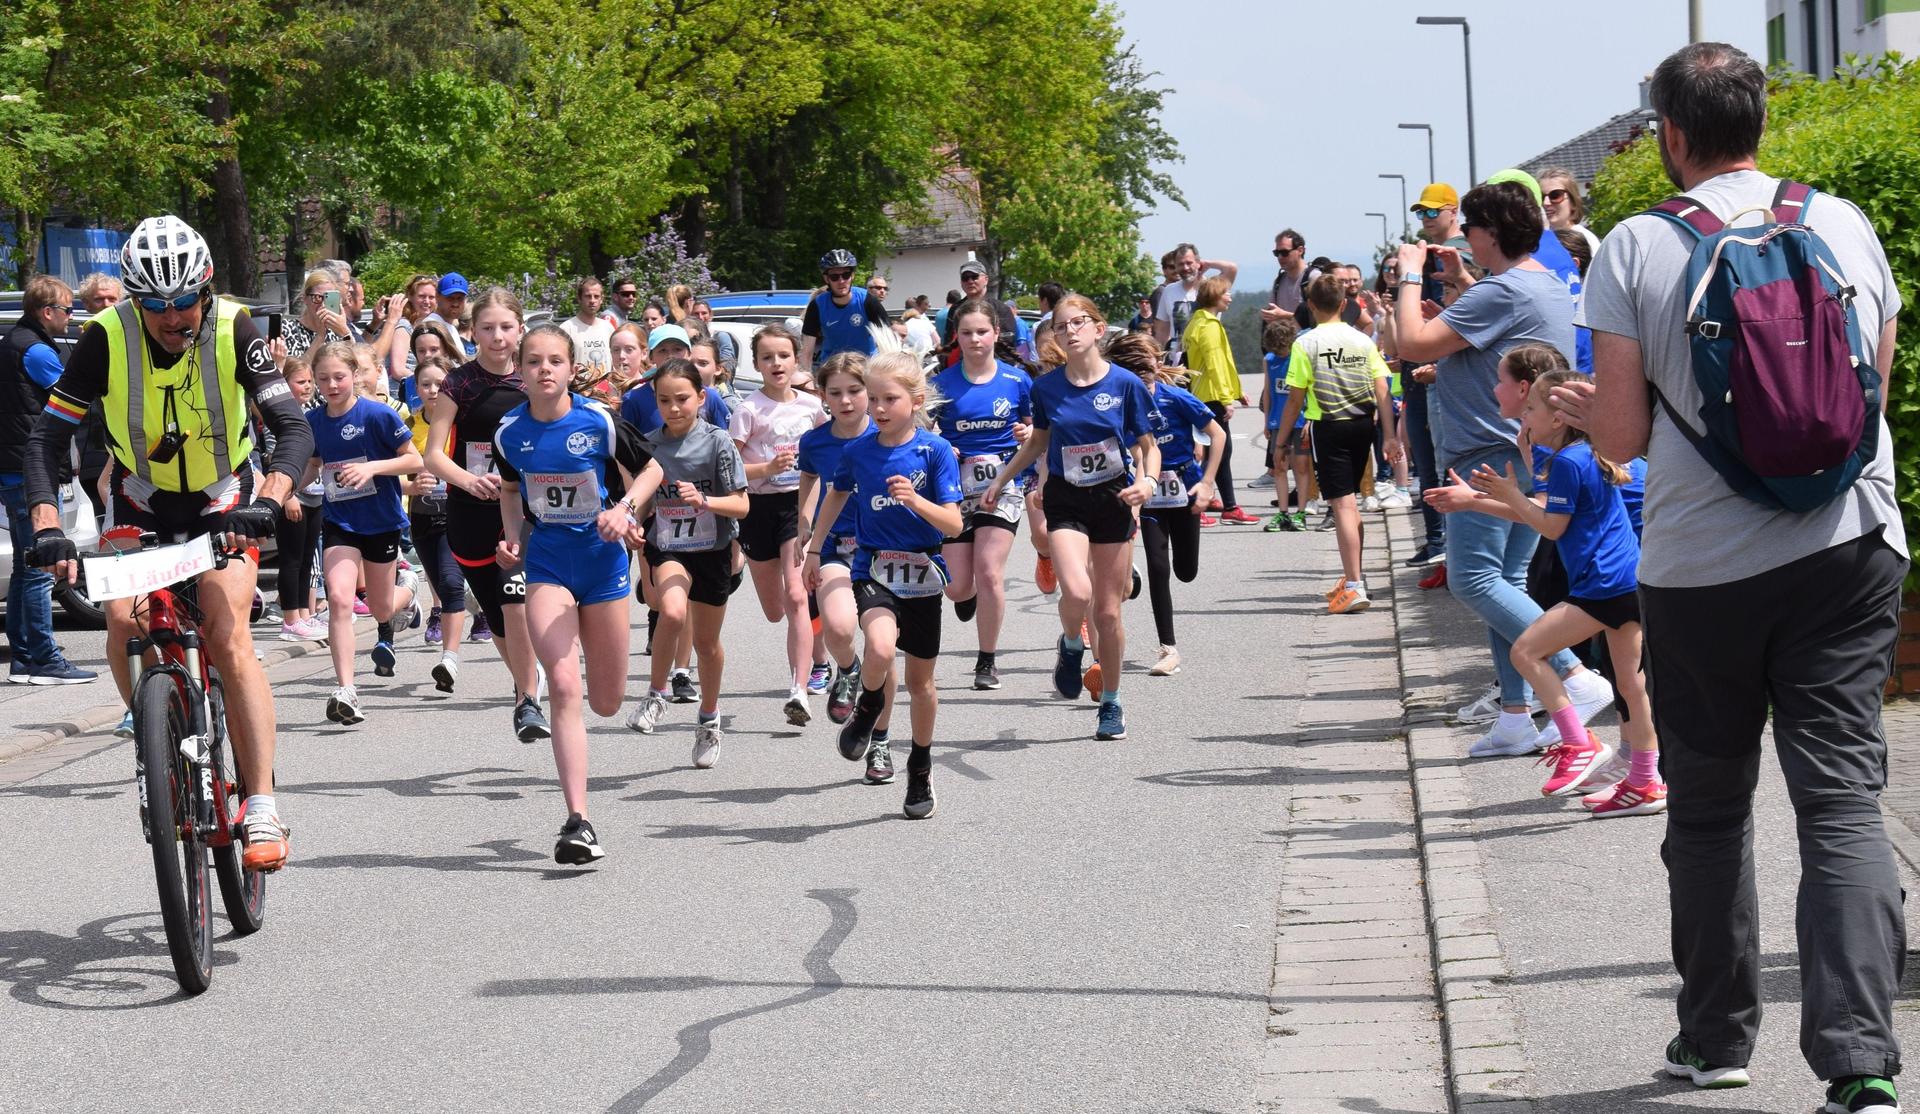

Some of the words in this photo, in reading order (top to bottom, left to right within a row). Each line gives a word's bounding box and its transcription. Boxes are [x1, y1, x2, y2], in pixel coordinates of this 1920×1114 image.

[583, 340, 606, 348] NASA
[955, 419, 1007, 432] CONRAD
[973, 463, 997, 482] 60
[1080, 453, 1108, 474] 92
[546, 486, 577, 508] 97
[871, 494, 904, 511] CONR
[670, 517, 697, 539] 77
[128, 556, 203, 592] Läufer
[883, 562, 929, 584] 117
